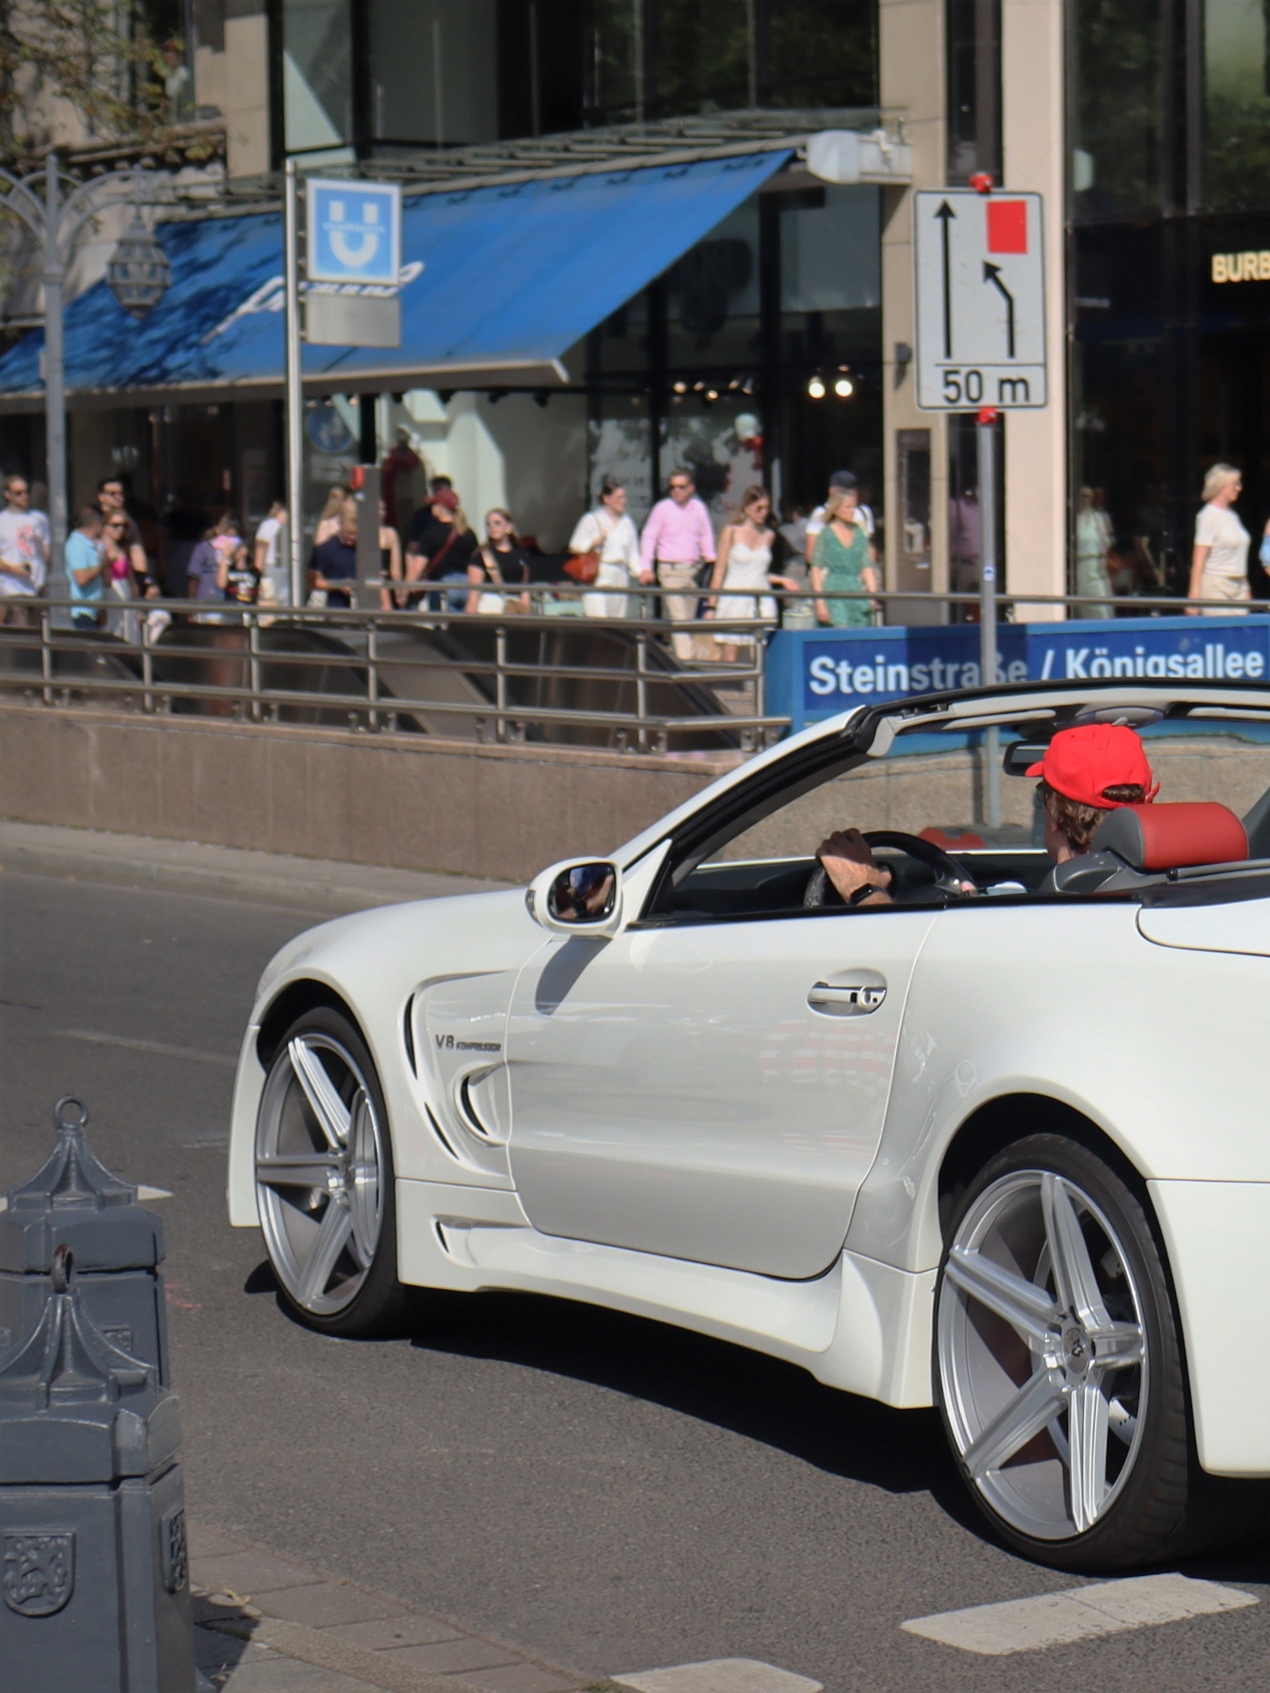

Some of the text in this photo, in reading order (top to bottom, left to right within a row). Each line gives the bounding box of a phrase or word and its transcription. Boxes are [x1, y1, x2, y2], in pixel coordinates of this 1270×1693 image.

[943, 369, 1030, 404] 50 m
[1065, 643, 1264, 679] Königsallee
[435, 1034, 454, 1050] V8
